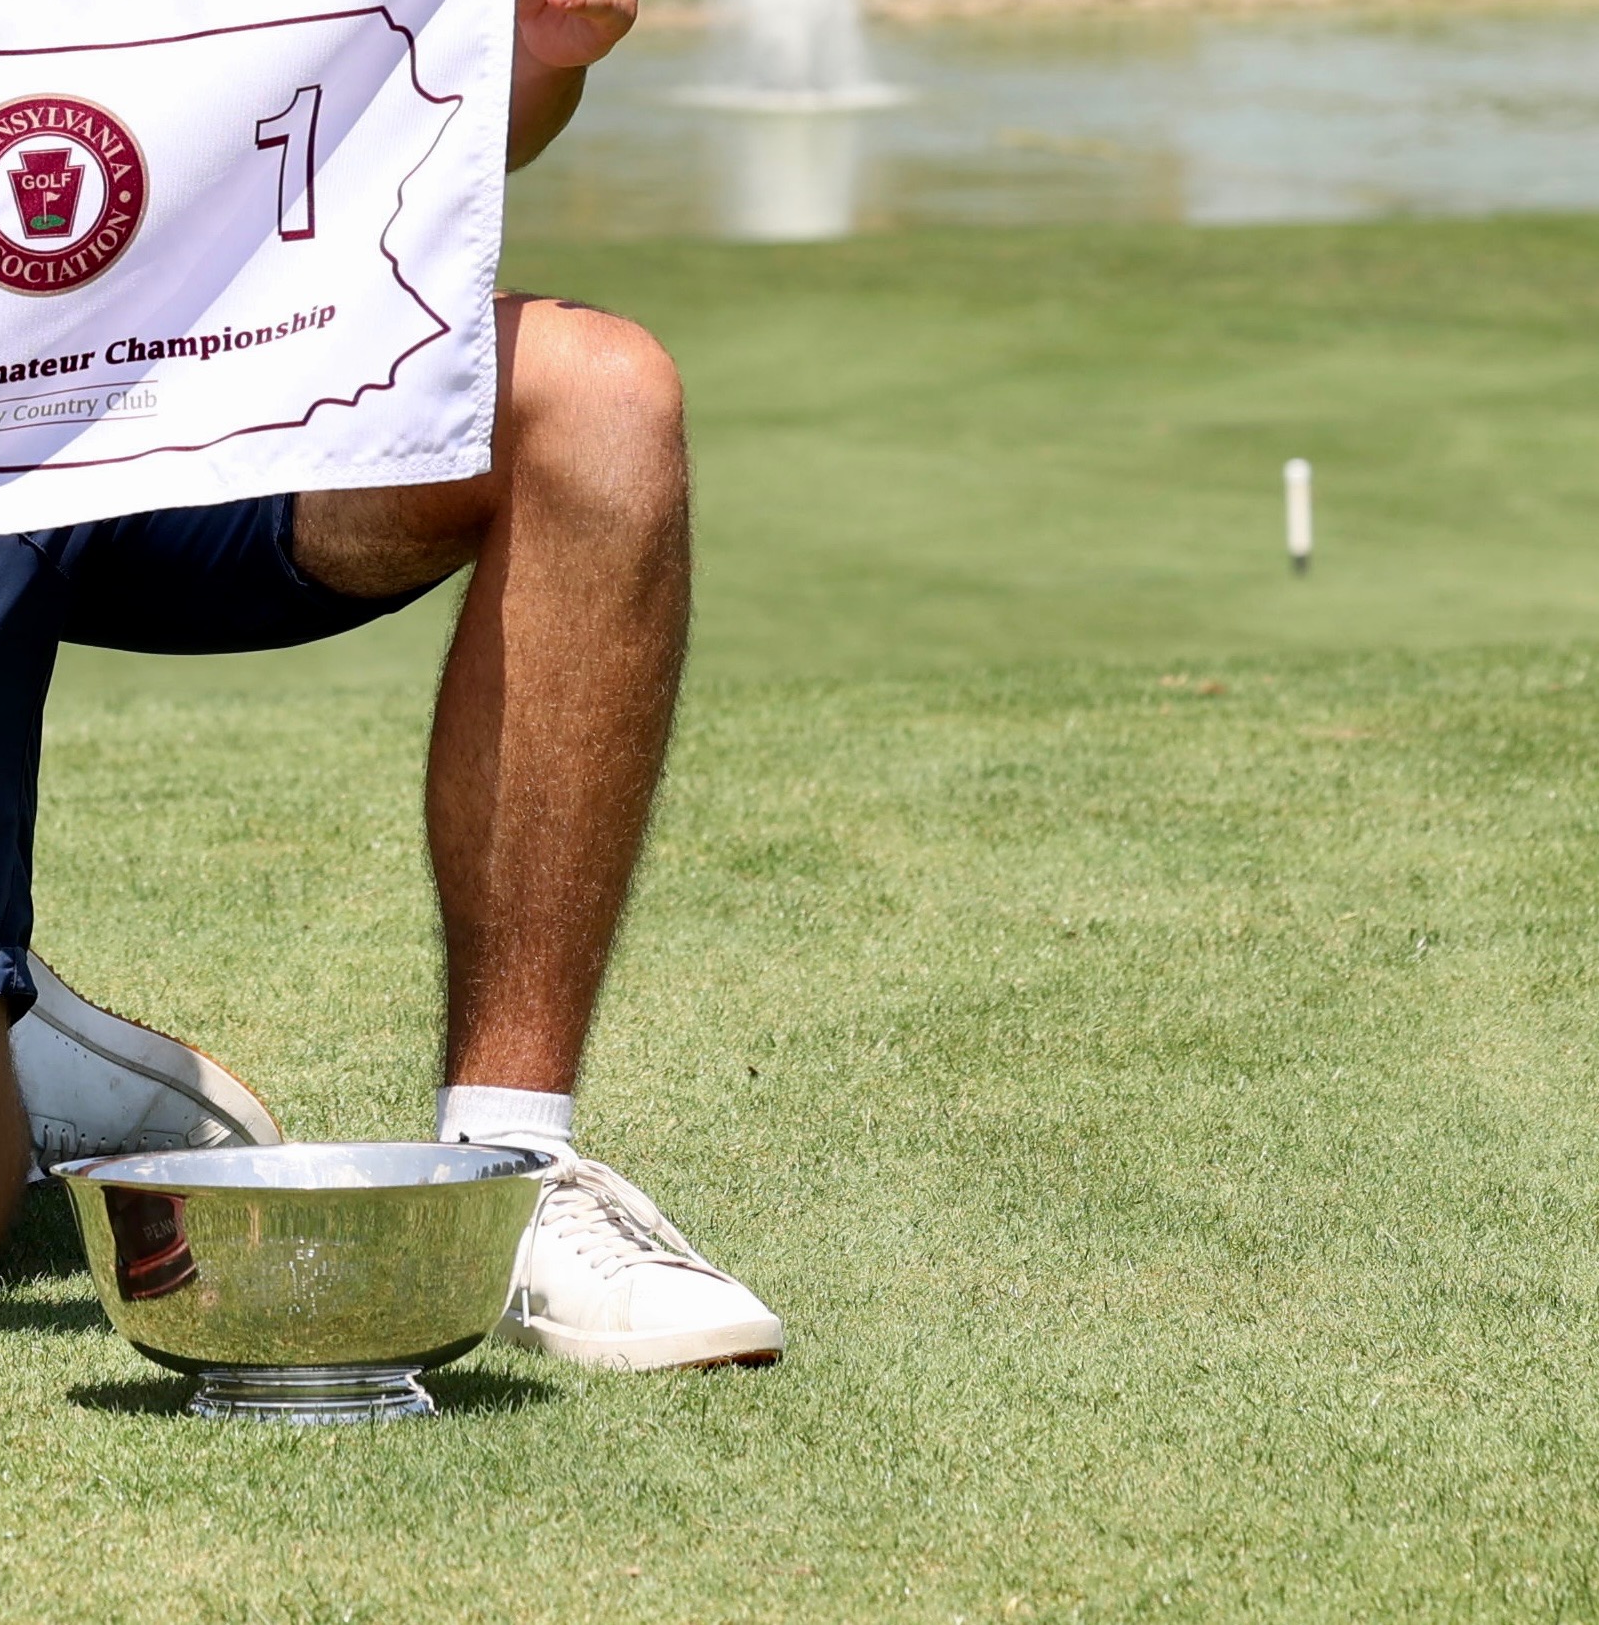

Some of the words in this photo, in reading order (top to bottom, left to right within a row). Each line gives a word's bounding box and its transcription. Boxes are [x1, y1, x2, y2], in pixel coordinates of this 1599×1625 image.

[21, 172, 72, 190] GOLF
[255, 83, 323, 243] 1
[104, 303, 337, 366] Championship
[12, 397, 99, 422] Country
[105, 390, 158, 413] Club
